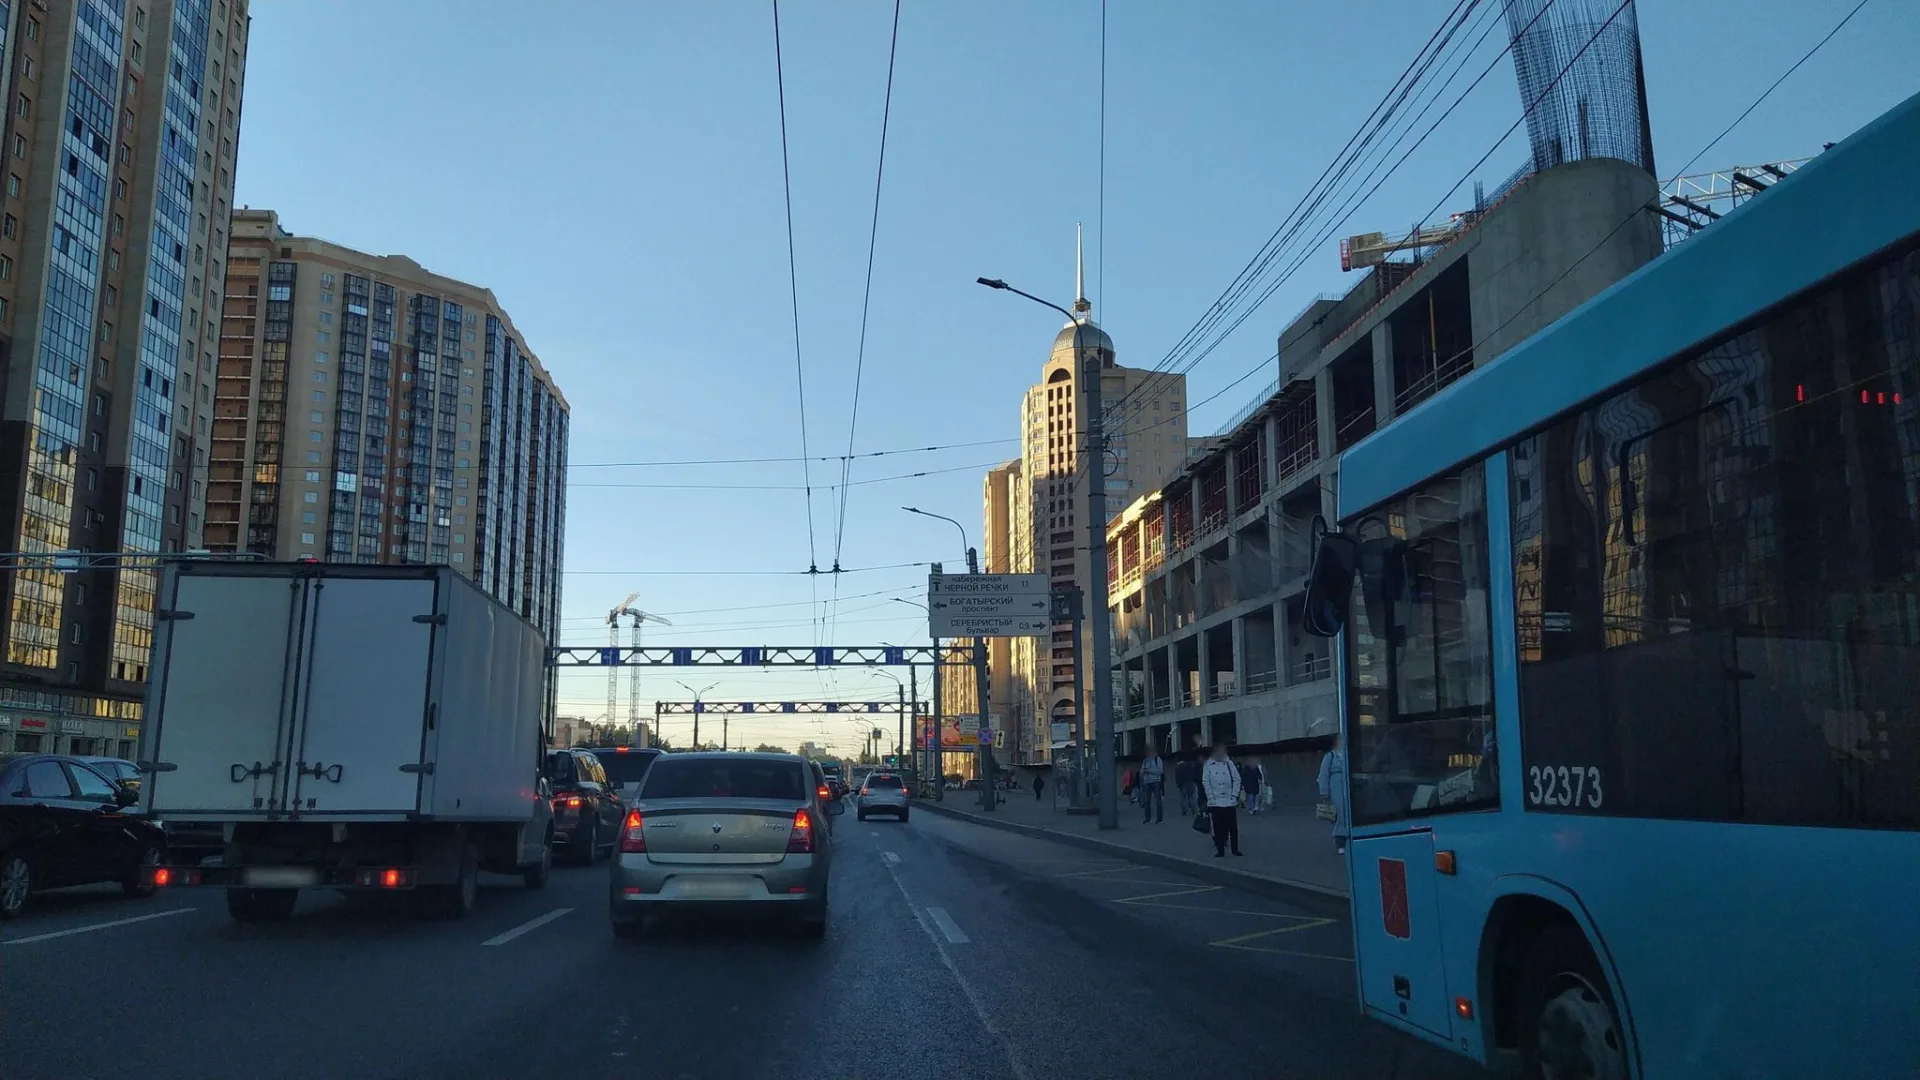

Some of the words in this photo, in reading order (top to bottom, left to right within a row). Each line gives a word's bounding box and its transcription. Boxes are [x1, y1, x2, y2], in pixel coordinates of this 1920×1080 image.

[951, 576, 1002, 584] набережная
[944, 582, 979, 592] ЧЕРНОЙ
[980, 584, 1009, 592] РЕЧКИ
[949, 595, 1014, 606] БОГАТЫРСКИЙ
[950, 618, 1012, 627] СЕРЕБРИСТЫЙ
[1019, 622, 1030, 630] 0,9
[966, 627, 999, 635] бульвар
[1530, 765, 1603, 809] 32373
